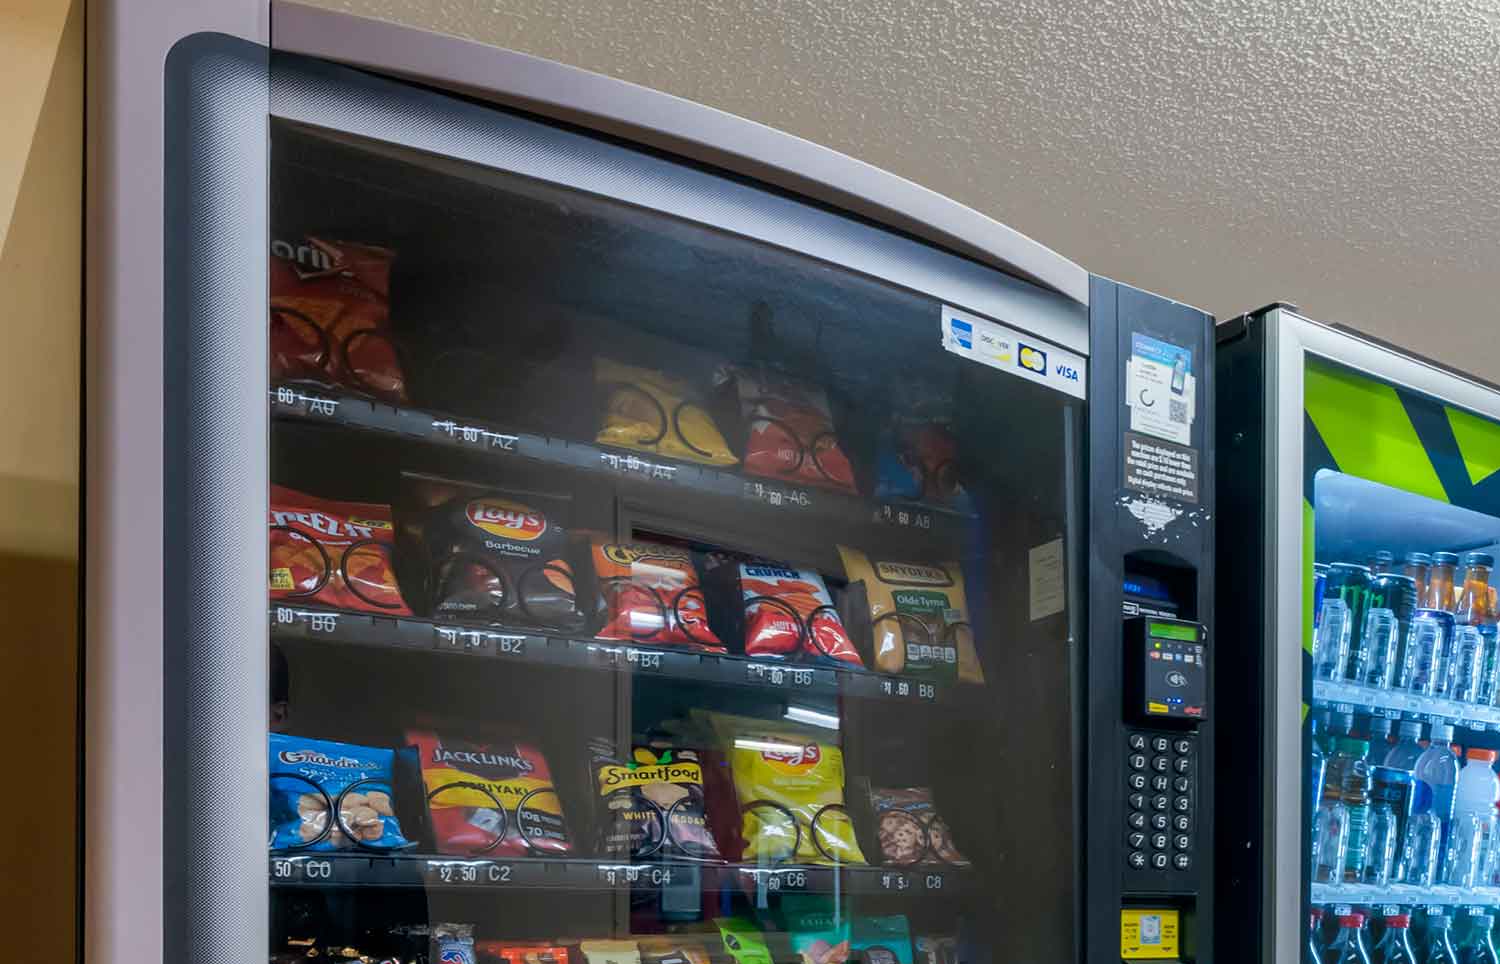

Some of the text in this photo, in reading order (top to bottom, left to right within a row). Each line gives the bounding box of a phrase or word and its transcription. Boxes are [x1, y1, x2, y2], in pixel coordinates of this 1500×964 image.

[1055, 364, 1080, 382] VISA
[484, 540, 541, 556] Barbecue
[1135, 737, 1145, 748] A
[1158, 739, 1167, 750] B
[1180, 741, 1189, 752] C
[434, 749, 480, 765] JACK
[1135, 756, 1145, 768] D
[1158, 759, 1167, 770] E
[1180, 760, 1189, 771] F
[607, 767, 699, 785] Smartfood
[1135, 776, 1144, 788] G
[1158, 778, 1168, 790] H
[1180, 780, 1188, 791] J
[1137, 796, 1143, 808] 1
[1157, 797, 1167, 809] 2
[1180, 799, 1188, 810] 3
[1135, 815, 1144, 826] 4
[1157, 816, 1166, 828] 5
[1179, 818, 1188, 829] 6
[1135, 835, 1144, 847] 7
[1157, 836, 1166, 848] 8
[1180, 837, 1188, 848] 9
[439, 864, 512, 882] $2.50 C2
[651, 869, 672, 885] C4
[926, 874, 942, 889] C8
